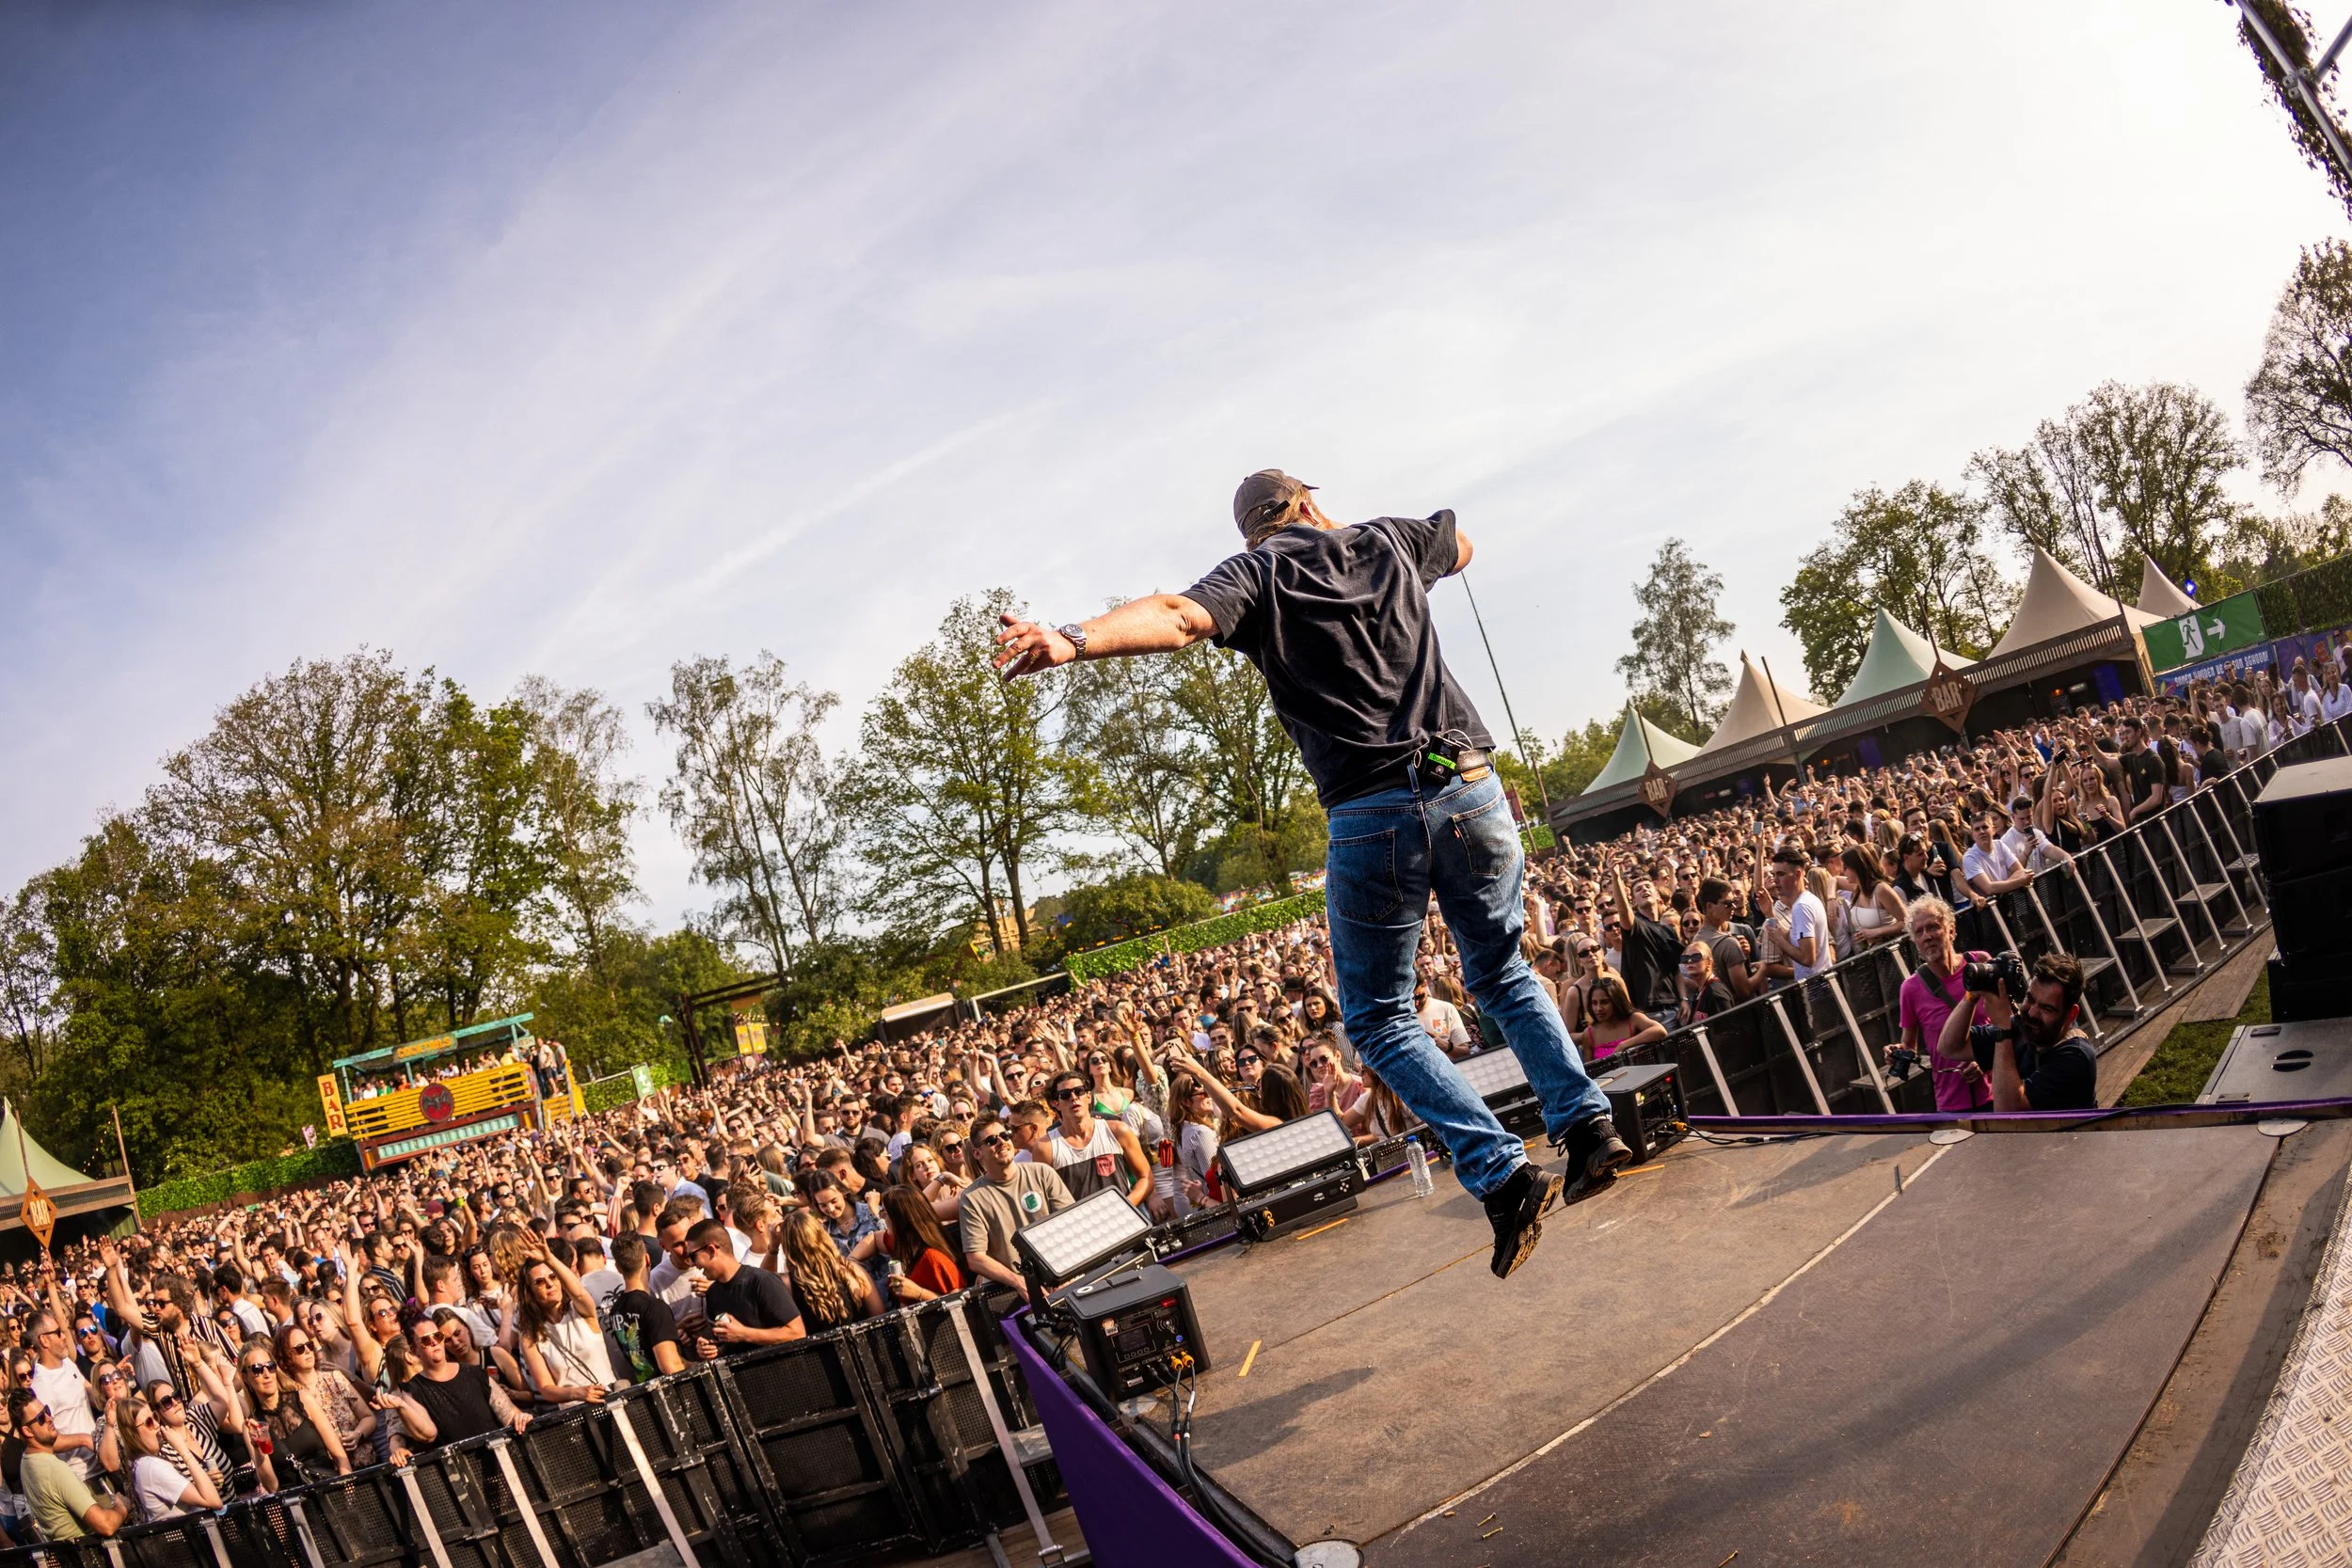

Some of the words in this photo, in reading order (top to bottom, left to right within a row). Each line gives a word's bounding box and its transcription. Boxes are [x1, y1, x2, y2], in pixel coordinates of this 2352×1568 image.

[2245, 651, 2269, 666] SCHOON!
[1931, 681, 1963, 712] BAR
[1645, 778, 1668, 801] BAR
[322, 1081, 344, 1131] BAR
[29, 1198, 51, 1227] BAR
